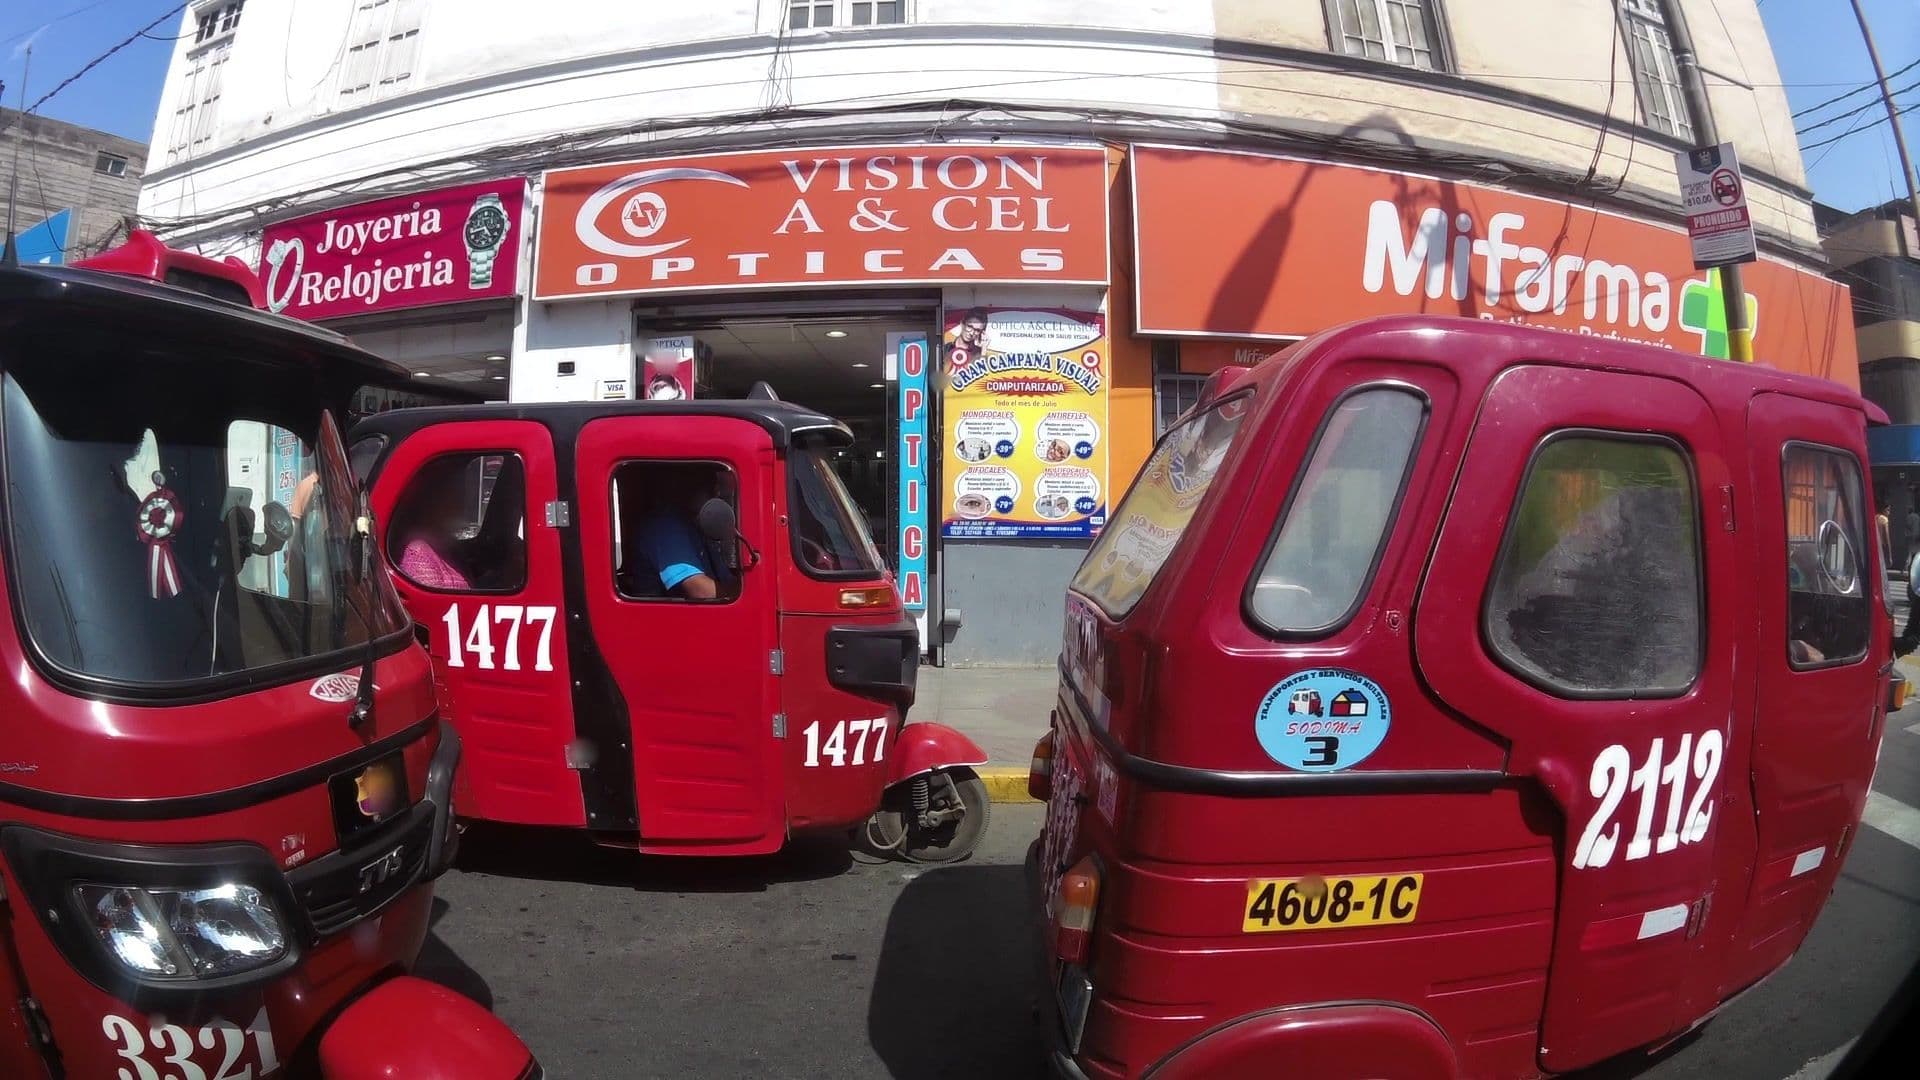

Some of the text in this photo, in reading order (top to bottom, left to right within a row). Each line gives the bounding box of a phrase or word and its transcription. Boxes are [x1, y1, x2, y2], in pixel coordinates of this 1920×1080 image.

[780, 155, 1047, 193] VISION
[316, 201, 442, 256] Joyeria
[773, 196, 1070, 234] A & CEL
[1693, 208, 1742, 229] PROHIBIDO
[298, 250, 455, 305] Relojeria
[576, 248, 1064, 286] OPTICAS
[1362, 199, 1671, 333] Mifarma
[607, 384, 624, 392] VISA
[986, 381, 1065, 392] COMPUTARIZADA
[988, 350, 1051, 372] CAMPAÑA
[1055, 357, 1100, 394] VISUAL
[962, 411, 1015, 419] MONOFOCALES
[1047, 412, 1089, 420] ANTIREFLEX
[904, 343, 922, 605] OPTICA
[442, 603, 557, 671] 1477
[1261, 673, 1309, 720] TRANSPORTES
[1318, 670, 1363, 684] SERVICIOS
[1363, 680, 1387, 720] MULTIPLES
[803, 716, 889, 767] 1477
[1286, 721, 1361, 735] SODIMA
[1302, 736, 1340, 766] 3
[1571, 729, 1724, 870] 2112
[1248, 876, 1418, 927] 4608-1C
[102, 1005, 280, 1080] 3321
